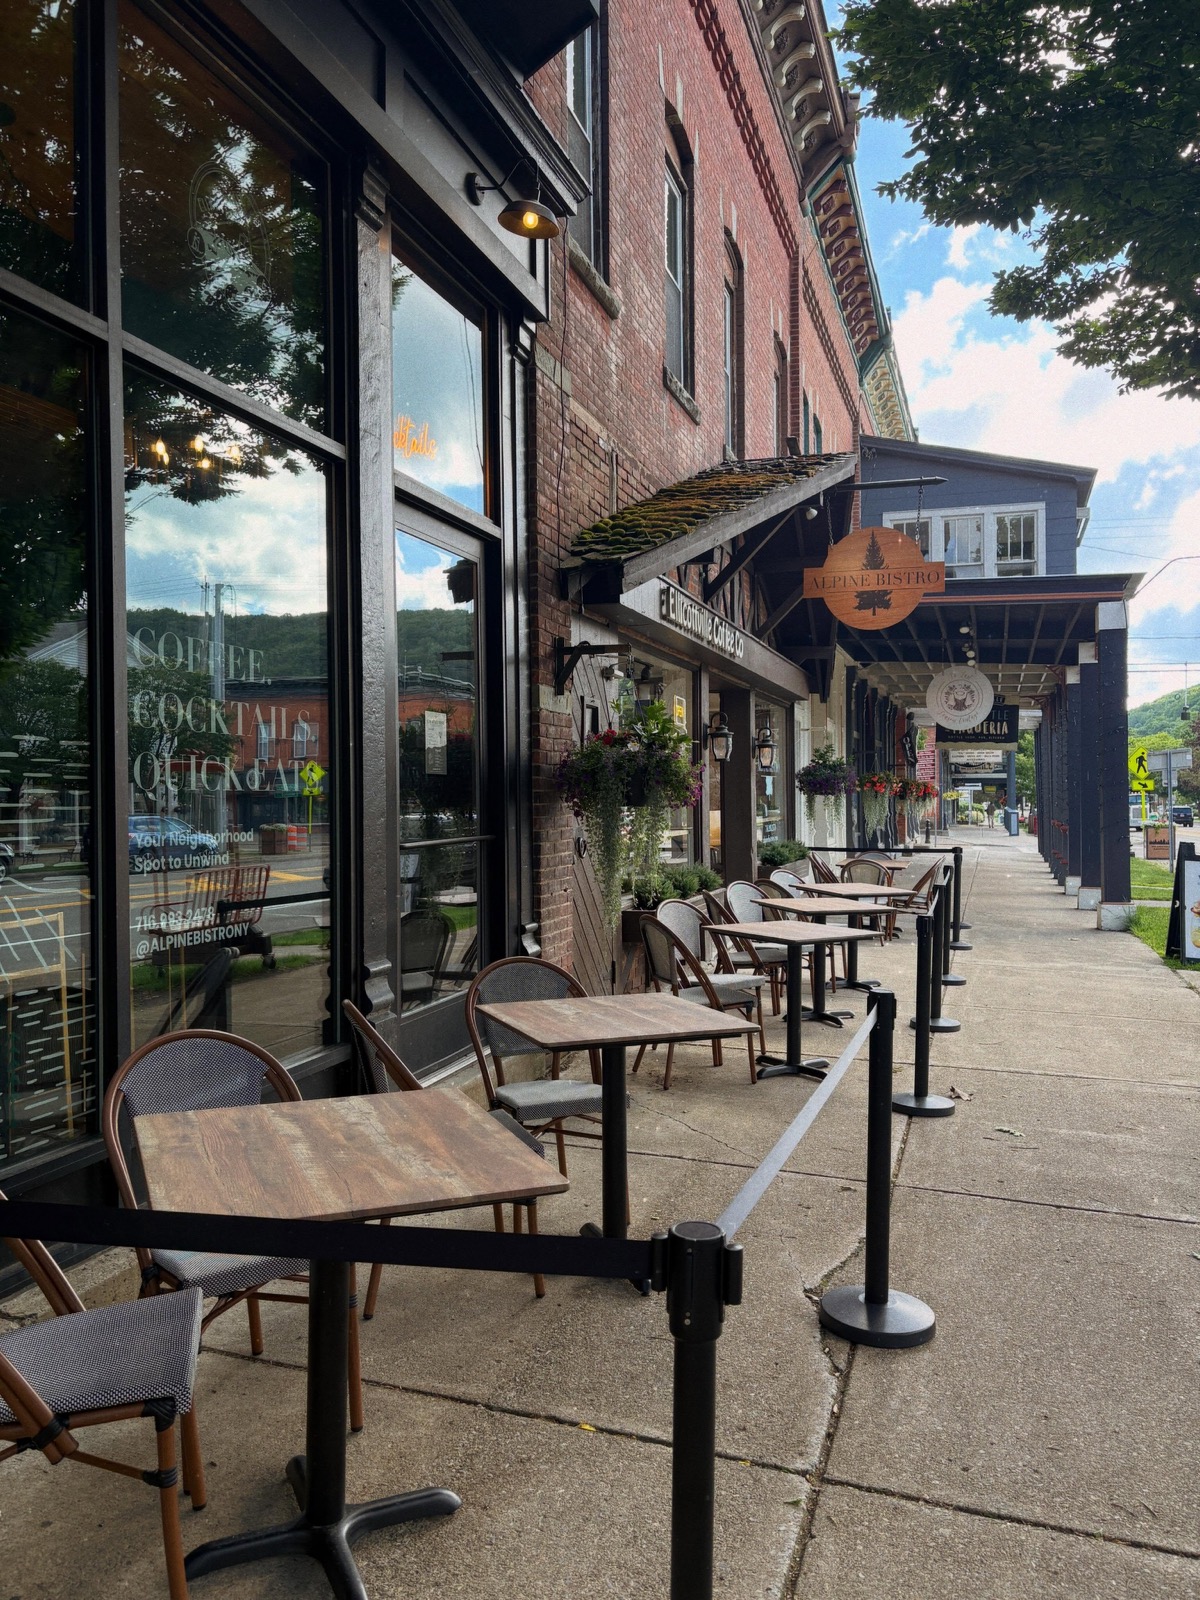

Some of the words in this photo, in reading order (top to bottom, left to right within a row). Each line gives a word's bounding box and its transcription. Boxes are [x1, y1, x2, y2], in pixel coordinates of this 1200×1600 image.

[809, 574, 871, 590] ALPINE
[876, 571, 940, 586] BISTRO
[714, 616, 734, 654] Coffee
[735, 630, 744, 659] Co
[133, 751, 245, 801] QUICK
[135, 833, 166, 849] Your
[135, 856, 166, 877] Spot
[169, 854, 181, 869] to
[184, 850, 230, 868] Unwind
[136, 922, 250, 960] @ALPINEBISTRONY
